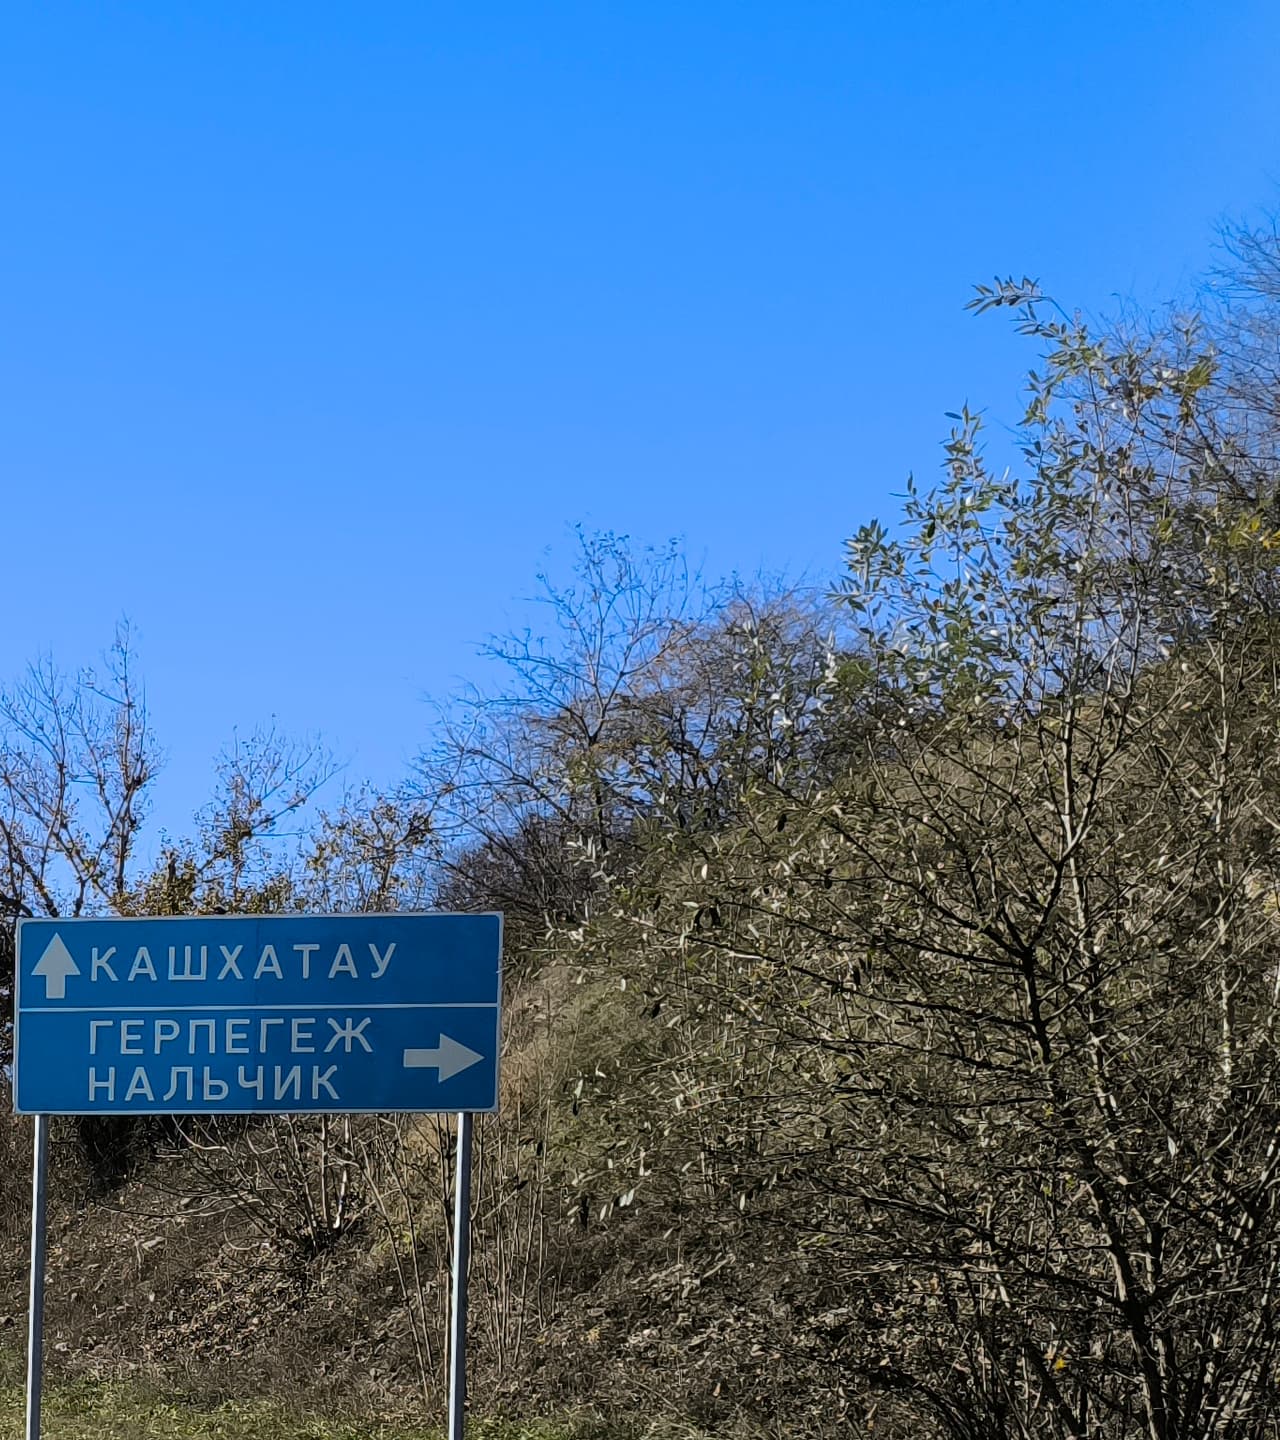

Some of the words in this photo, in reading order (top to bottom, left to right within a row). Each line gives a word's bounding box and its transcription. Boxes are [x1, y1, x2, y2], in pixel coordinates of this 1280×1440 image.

[90, 943, 397, 982] КАШХАТАУ
[88, 1017, 374, 1055] ГЕРПЕГЕЖ
[87, 1064, 341, 1102] НАЛЬЧИК
